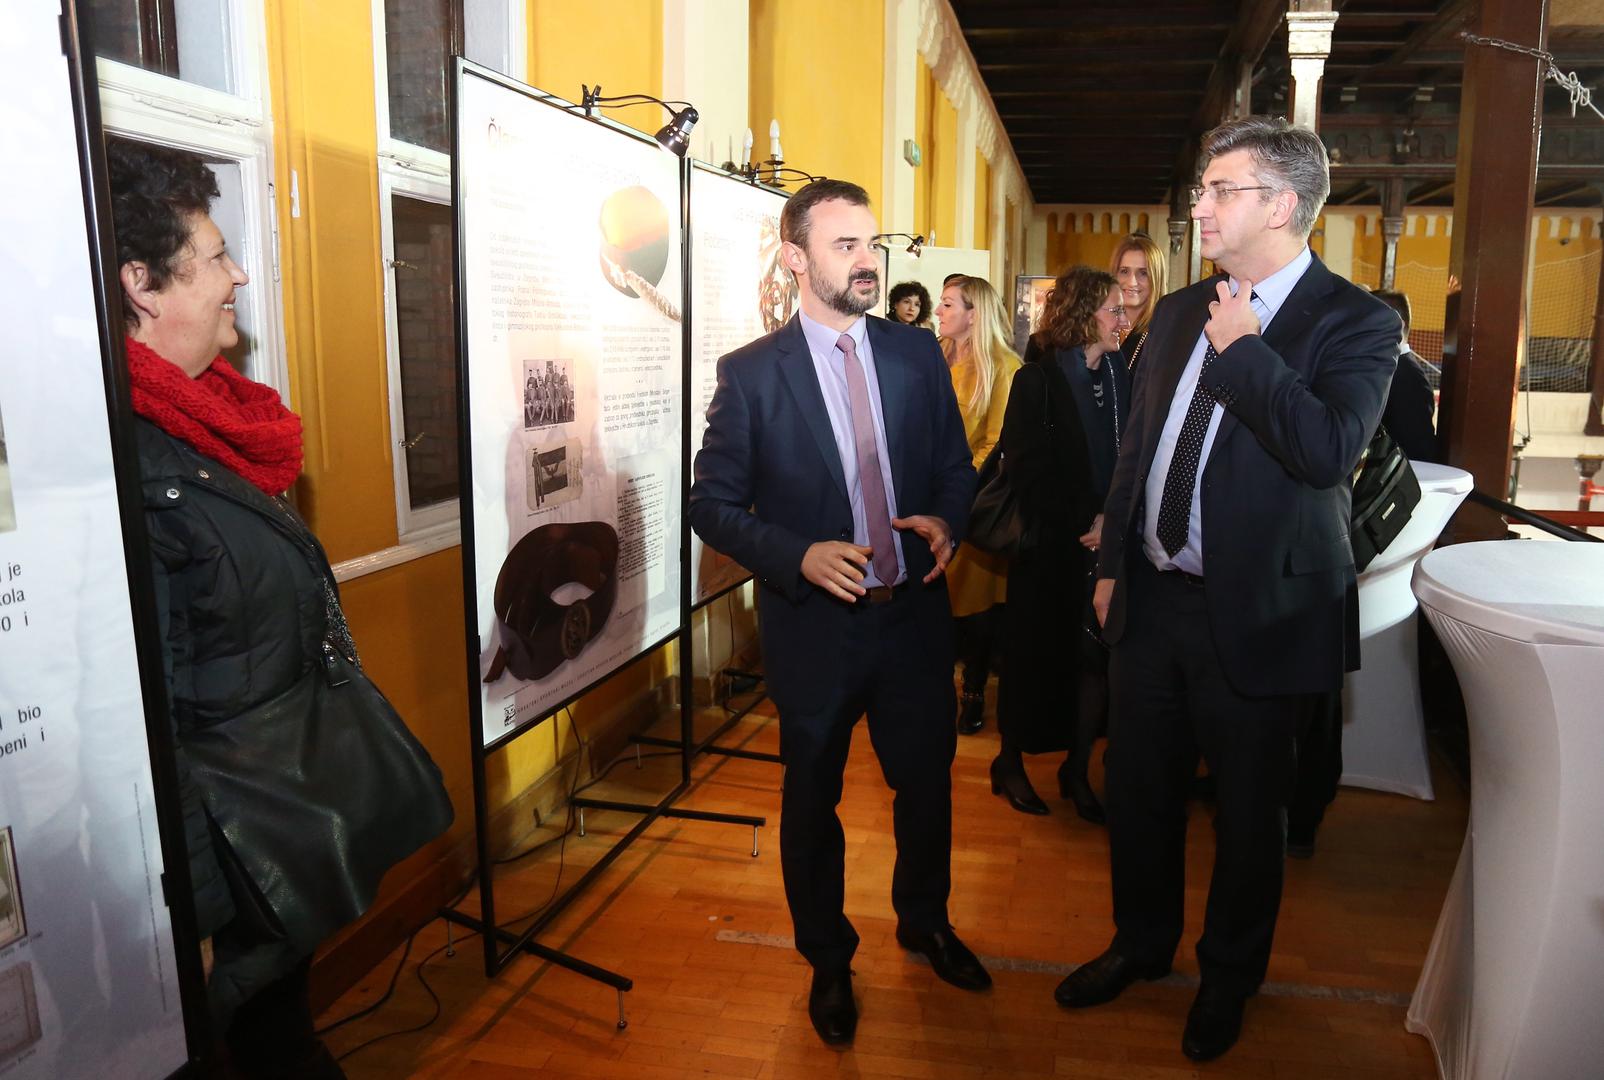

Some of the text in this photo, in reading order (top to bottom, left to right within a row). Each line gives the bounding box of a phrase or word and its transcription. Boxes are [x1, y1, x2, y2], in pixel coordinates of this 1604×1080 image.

[8, 561, 21, 581] je
[0, 588, 25, 606] ola
[0, 611, 28, 631] 0 i
[18, 705, 41, 724] bio
[40, 727, 45, 742] i
